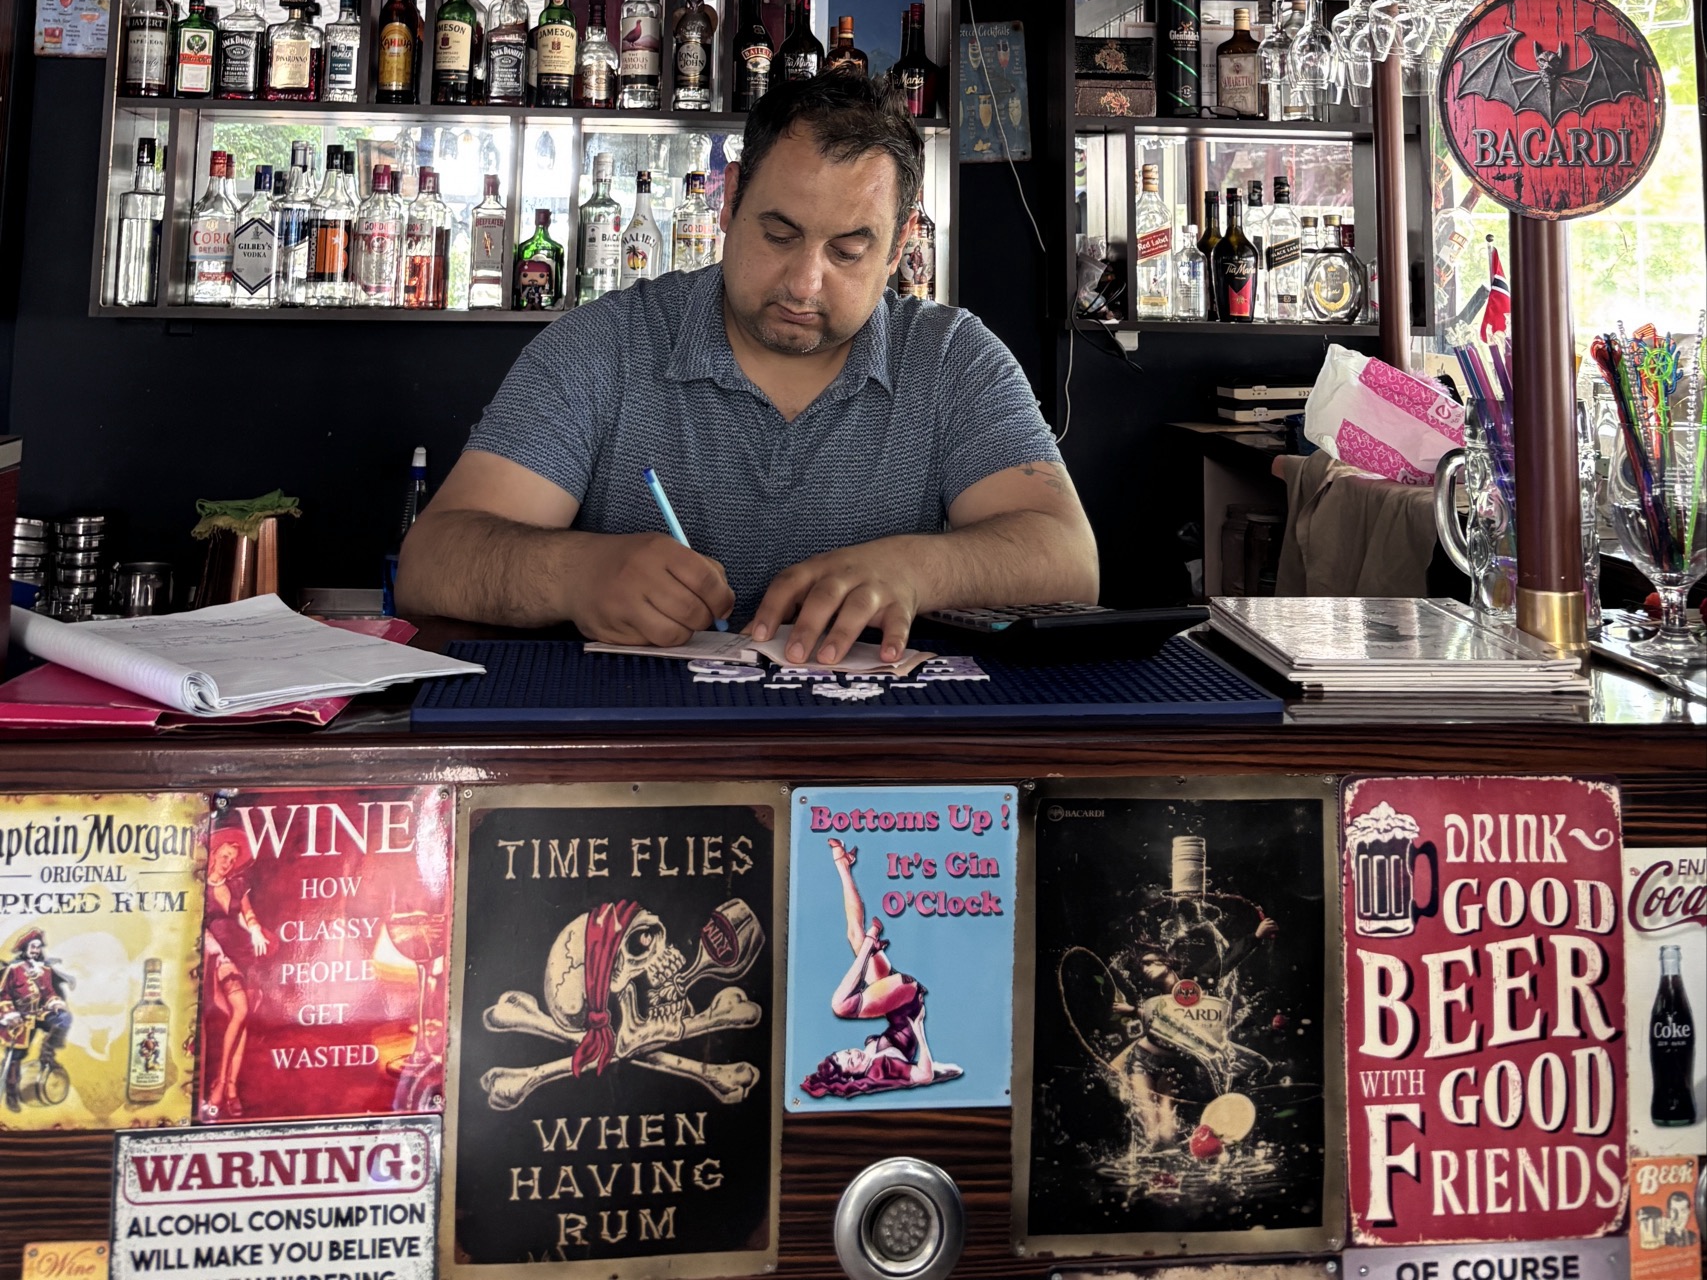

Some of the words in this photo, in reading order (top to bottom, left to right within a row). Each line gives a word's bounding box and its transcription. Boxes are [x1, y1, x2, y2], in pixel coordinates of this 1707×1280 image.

[539, 28, 574, 40] JAMESON
[491, 50, 504, 59] JACK
[680, 59, 704, 68] JOHN
[900, 73, 924, 85] Maria
[1473, 127, 1632, 167] BACARDI
[476, 218, 503, 227] BEEFEATER
[193, 231, 231, 246] CORK
[238, 242, 273, 250] GILBEY'S
[810, 806, 939, 832] Bottoms
[948, 805, 993, 836] Up
[1064, 809, 1105, 818] BACARDI
[0, 816, 78, 865] ptain
[76, 814, 195, 863] Morgan
[235, 800, 415, 860] WINE
[1444, 813, 1567, 863] DRINK
[497, 838, 610, 880] TIME
[631, 835, 755, 878] FLIES
[886, 852, 937, 879] It's
[944, 852, 1000, 878] Gin
[40, 865, 127, 884] ORIGINAL
[300, 876, 363, 899] HOW
[110, 890, 189, 914] RUM
[882, 891, 1003, 918] O'Clock
[1442, 878, 1616, 935] GOOD
[279, 918, 380, 942] CLASSY
[281, 960, 375, 985] PEOPLE
[1356, 934, 1619, 1060] BEER
[298, 1003, 349, 1026] GET
[1654, 1022, 1691, 1038] Coke
[271, 1044, 380, 1069] WASTED
[1359, 1069, 1426, 1098] WITH
[1439, 1046, 1614, 1138] GOOD
[532, 1111, 707, 1153] WHEN
[131, 1143, 421, 1194] WARNING:
[1365, 1103, 1622, 1227] FRIENDS
[509, 1158, 725, 1201] HAVING
[1636, 1165, 1693, 1195] BEER
[127, 1212, 243, 1239] ALCOHOL
[248, 1203, 425, 1233] CONSUMPTION
[558, 1206, 677, 1246] RUM
[36, 1248, 96, 1277] Wine
[130, 1248, 189, 1272] WILL
[193, 1244, 263, 1269] MAKE
[269, 1241, 323, 1264] YOU
[328, 1236, 421, 1261] BELIEVE
[1396, 1262, 1438, 1280] OF
[1452, 1255, 1580, 1280] COURSE
